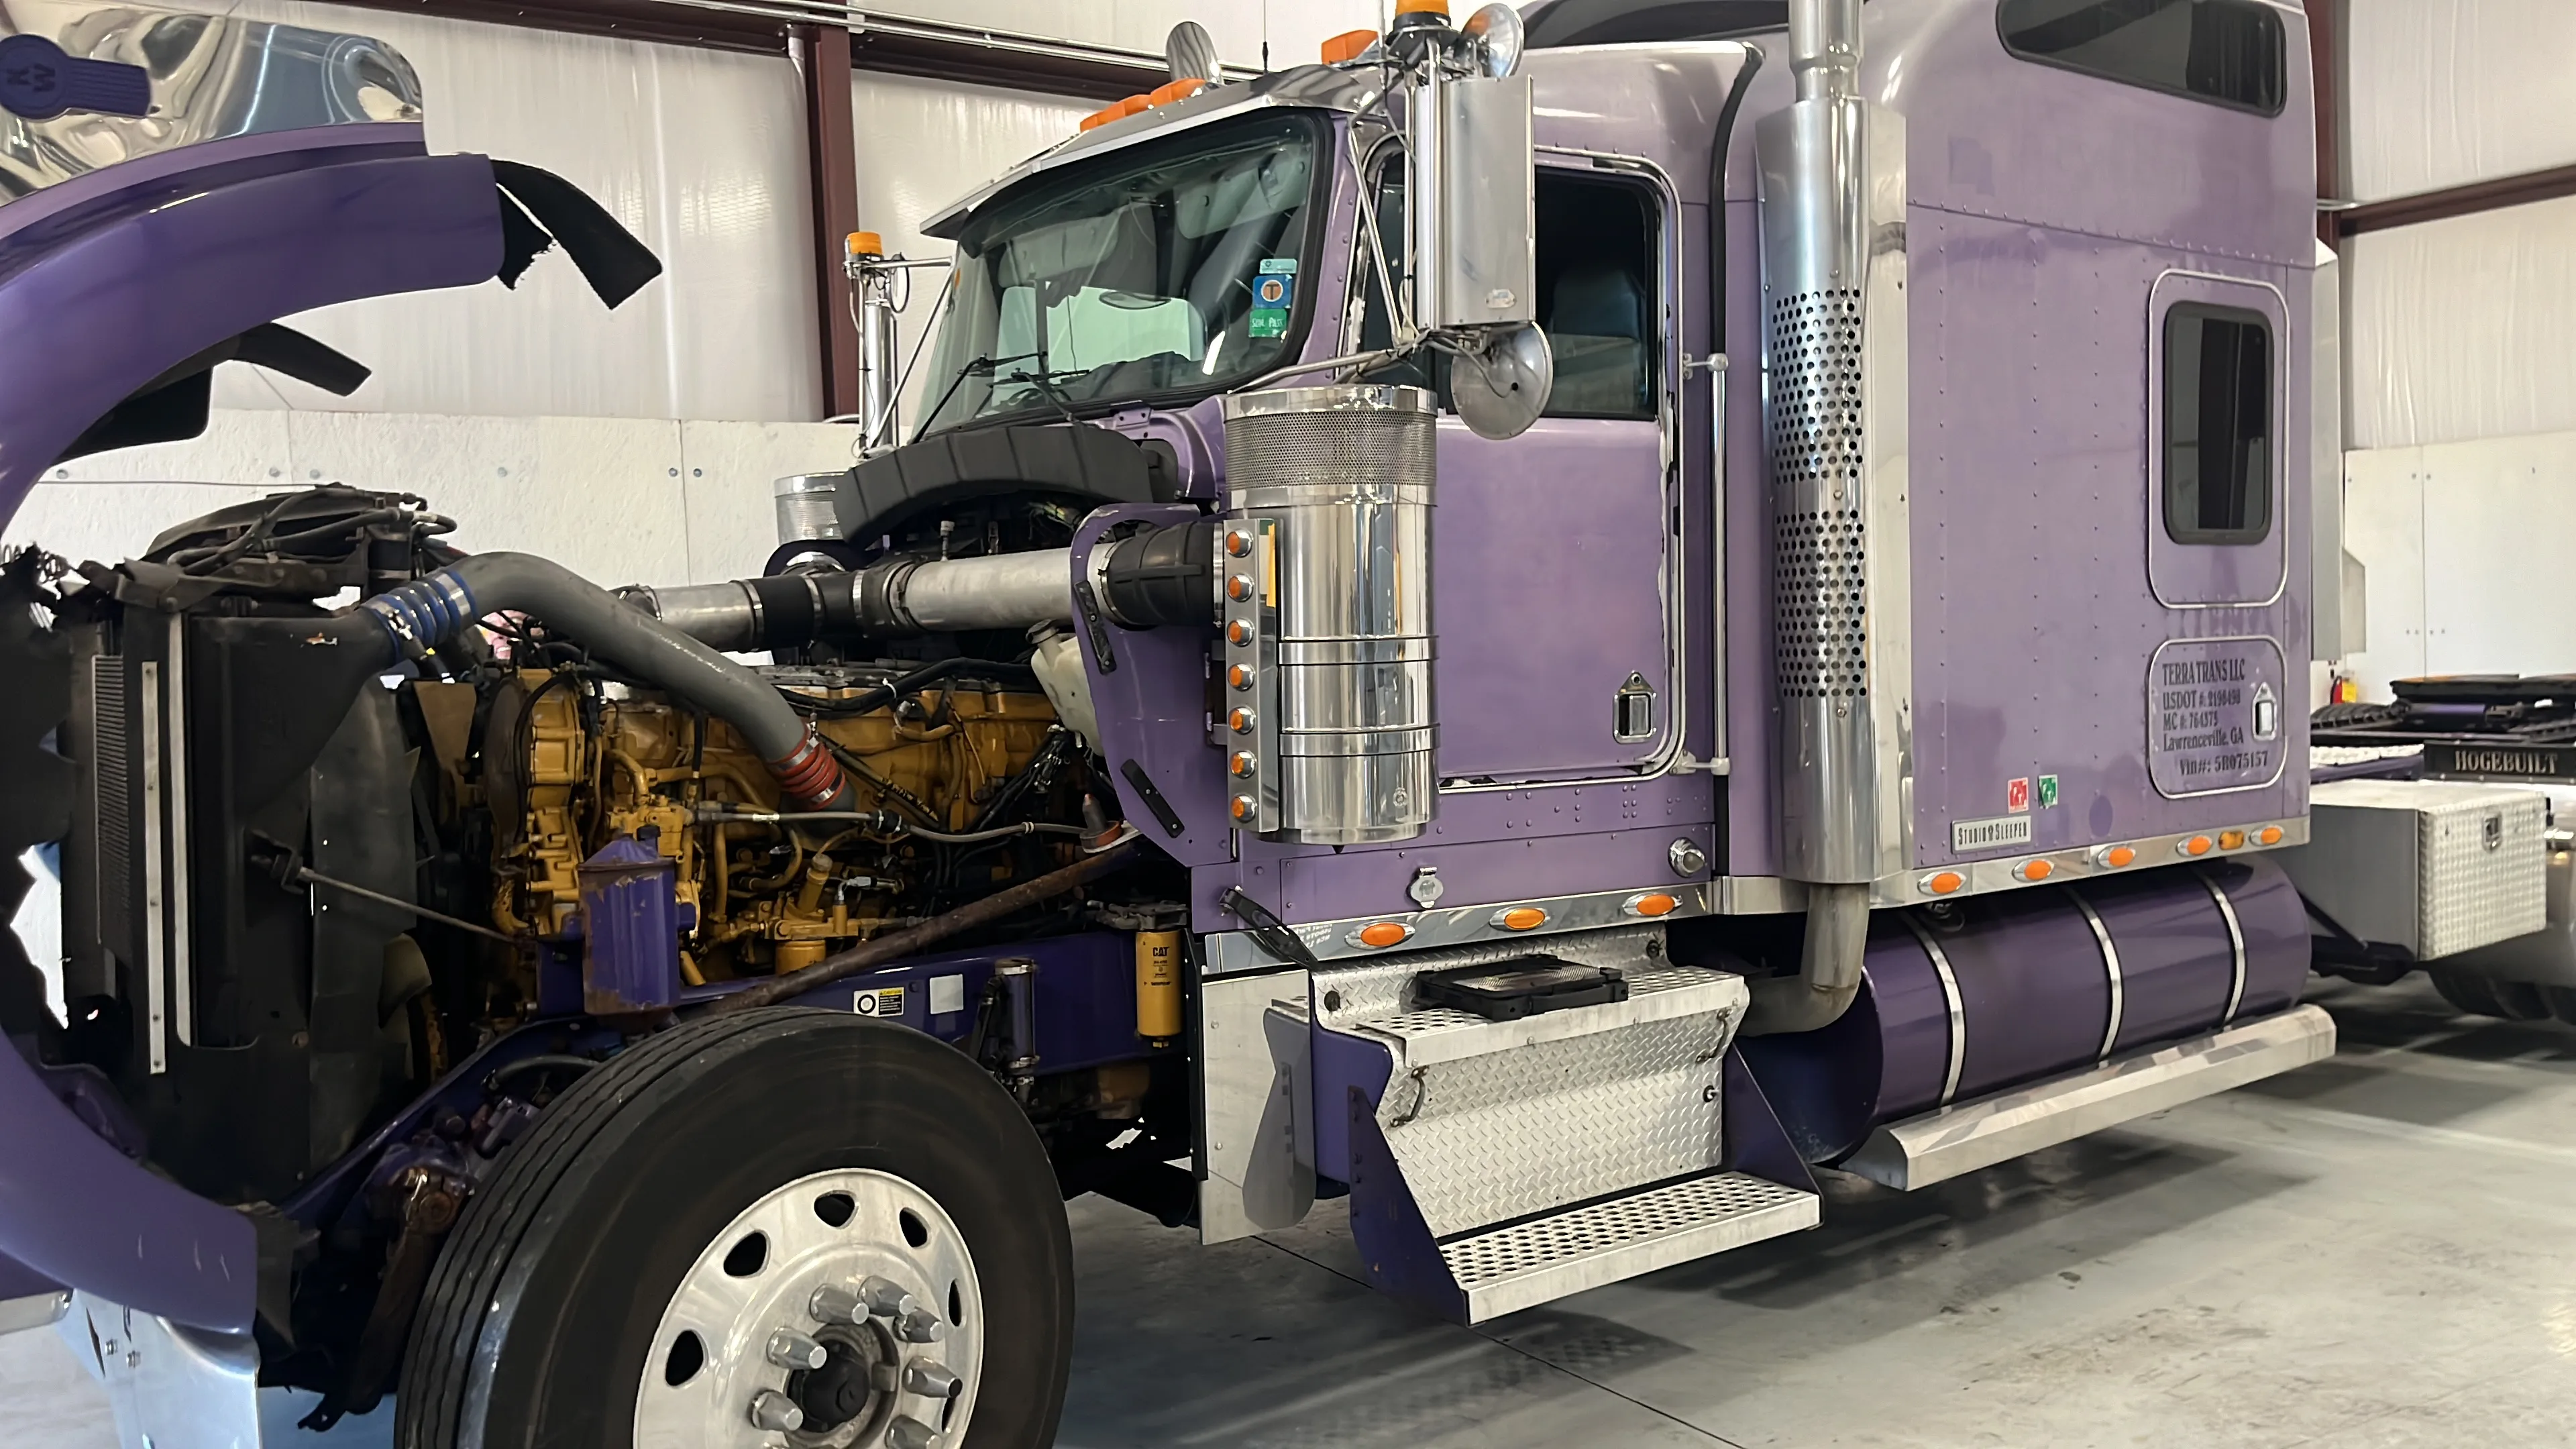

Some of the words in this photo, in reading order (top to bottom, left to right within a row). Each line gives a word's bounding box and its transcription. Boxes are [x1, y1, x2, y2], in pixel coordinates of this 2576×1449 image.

[2162, 661, 2195, 686] TERRA
[2196, 659, 2227, 684] TRANS
[2230, 658, 2245, 682] LLC
[2163, 690, 2197, 710] USDOT
[2163, 712, 2178, 731] MC
[2231, 727, 2244, 745] GA
[2455, 750, 2558, 774] HOGEBUILT
[1152, 947, 1170, 957] CAT
